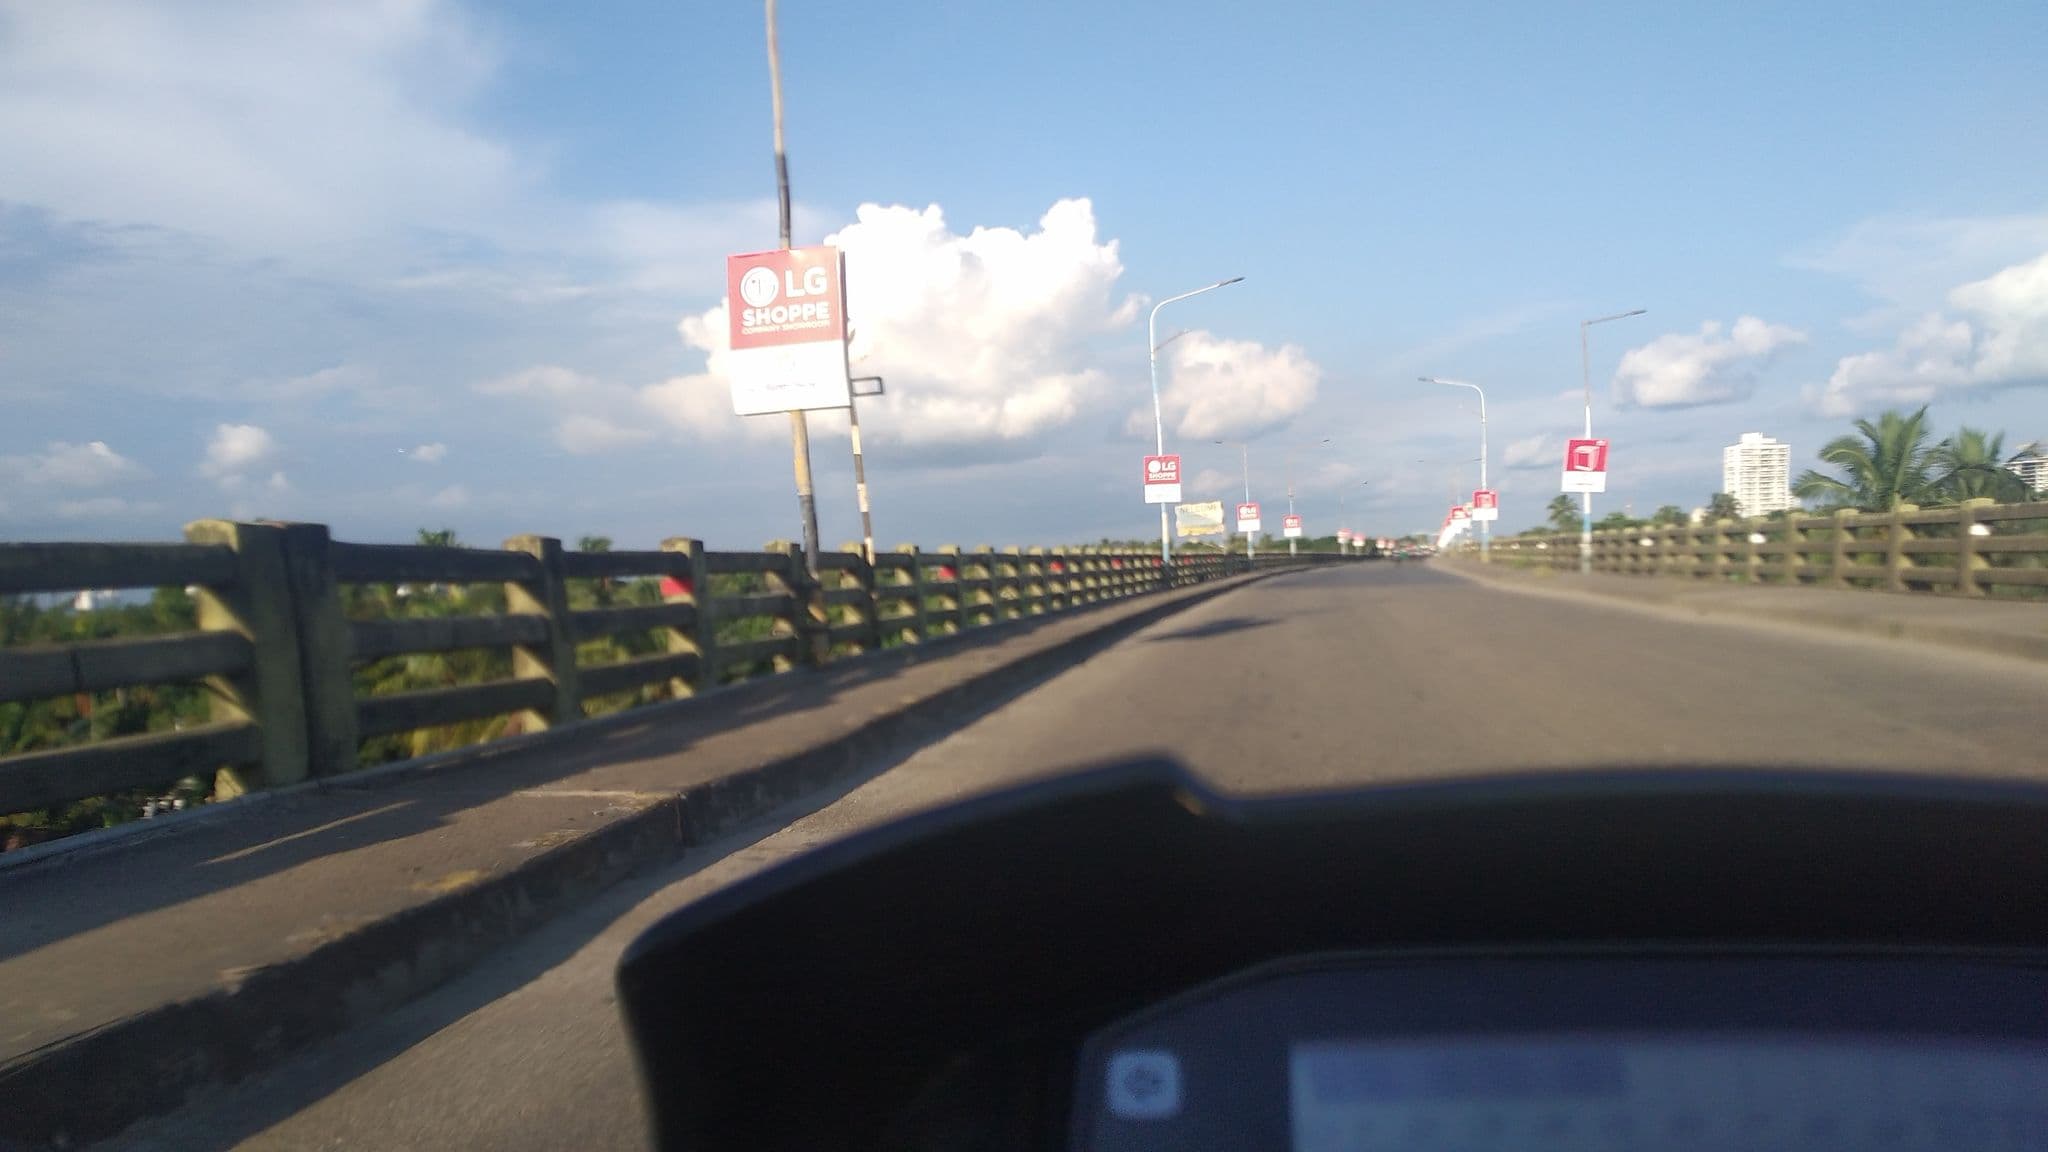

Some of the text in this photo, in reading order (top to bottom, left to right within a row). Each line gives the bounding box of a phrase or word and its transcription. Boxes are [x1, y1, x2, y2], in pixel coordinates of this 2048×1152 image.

[785, 267, 827, 298] LG
[742, 302, 830, 327] SHOPPE
[1161, 461, 1176, 471] LG
